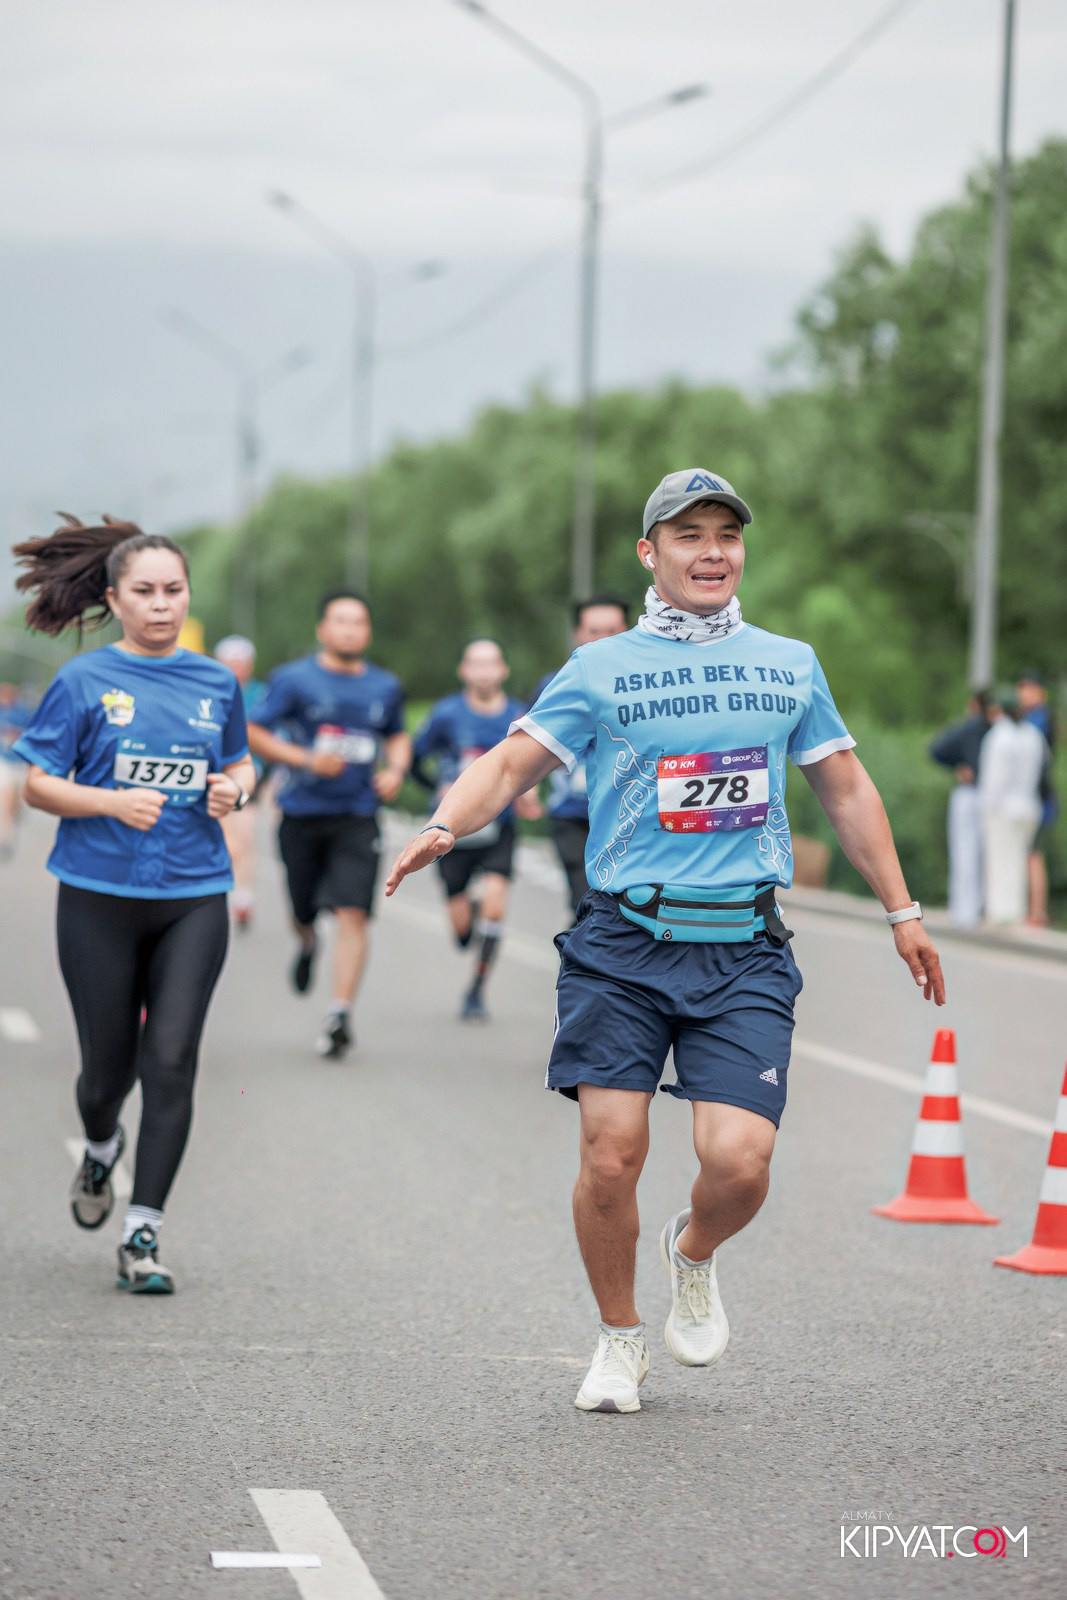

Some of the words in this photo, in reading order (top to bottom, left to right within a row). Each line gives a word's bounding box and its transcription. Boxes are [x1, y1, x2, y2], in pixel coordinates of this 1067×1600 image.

[614, 667, 695, 694] ASKAR
[702, 665, 749, 683] BEK
[755, 666, 795, 686] TAU
[618, 694, 719, 728] QAMQOR
[728, 692, 797, 716] GROUP
[663, 760, 677, 770] 10
[680, 760, 696, 769] KM
[731, 755, 752, 763] GROUP
[129, 761, 194, 785] 1379
[680, 775, 749, 808] 278
